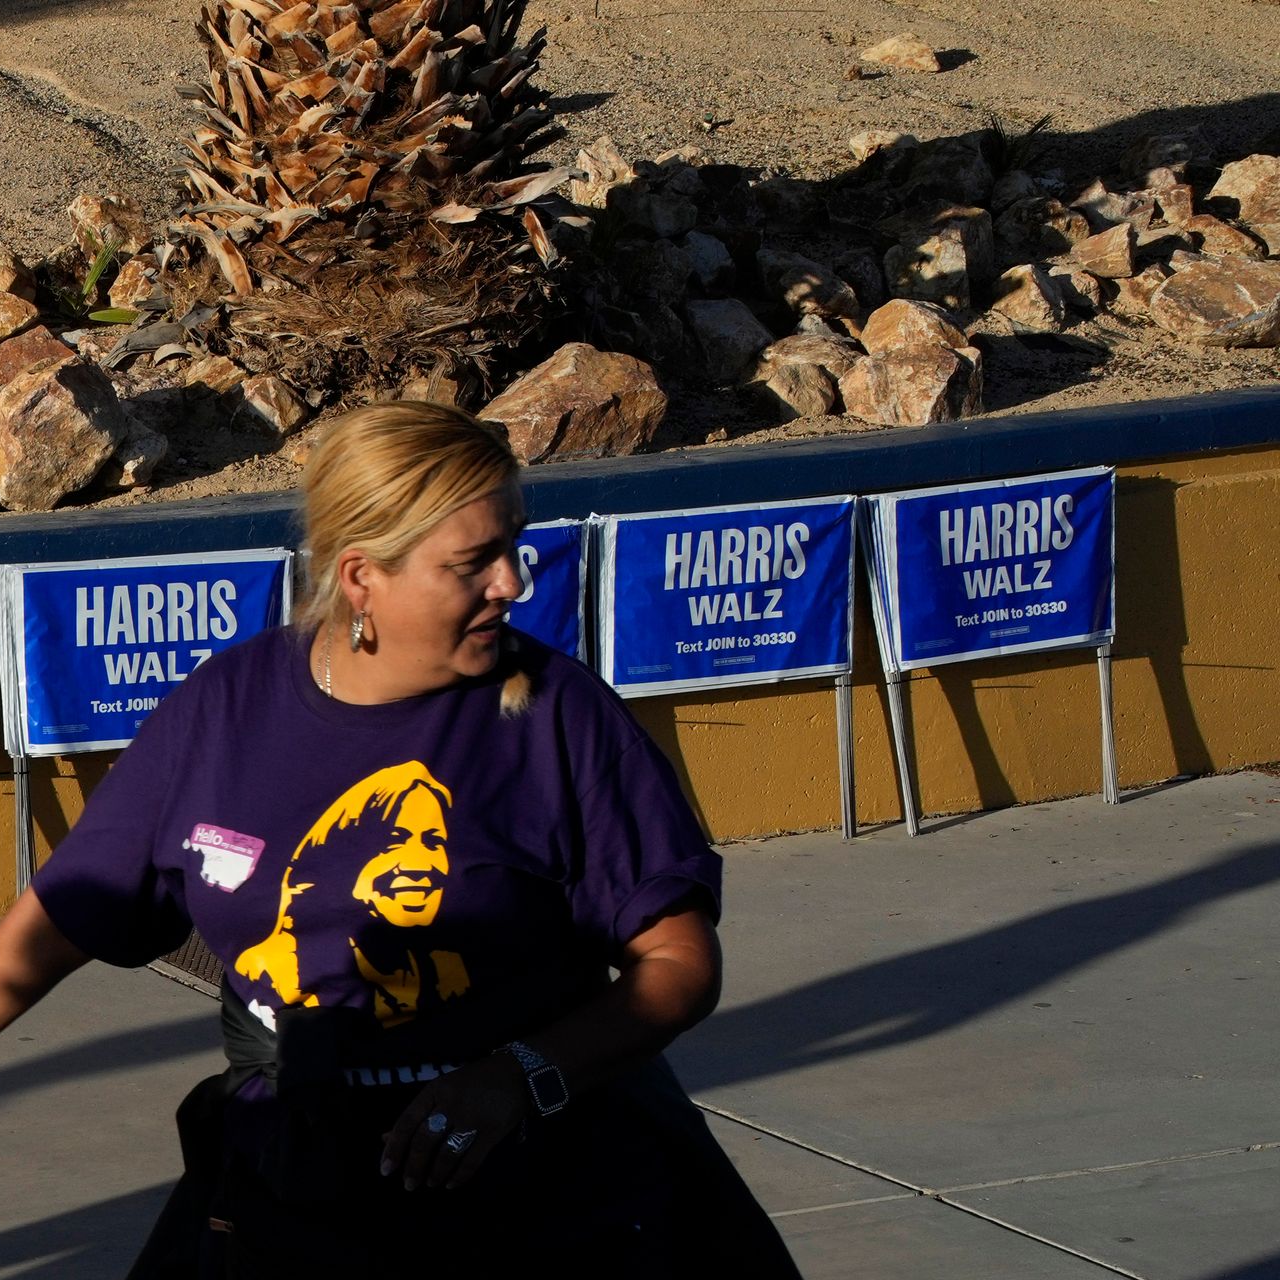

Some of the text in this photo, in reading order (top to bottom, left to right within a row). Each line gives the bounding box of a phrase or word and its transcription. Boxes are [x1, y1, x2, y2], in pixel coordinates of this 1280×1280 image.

[939, 494, 1074, 566] HARRIS
[664, 522, 810, 590] HARRIS
[964, 560, 1052, 599] WALZ
[77, 580, 237, 646] HARRIS
[688, 589, 782, 625] WALZ
[956, 601, 1066, 626] Text JOIN to 30330
[676, 632, 796, 653] Text JOIN to 30330
[91, 698, 158, 713] Text JOIN
[194, 827, 223, 845] Hello
